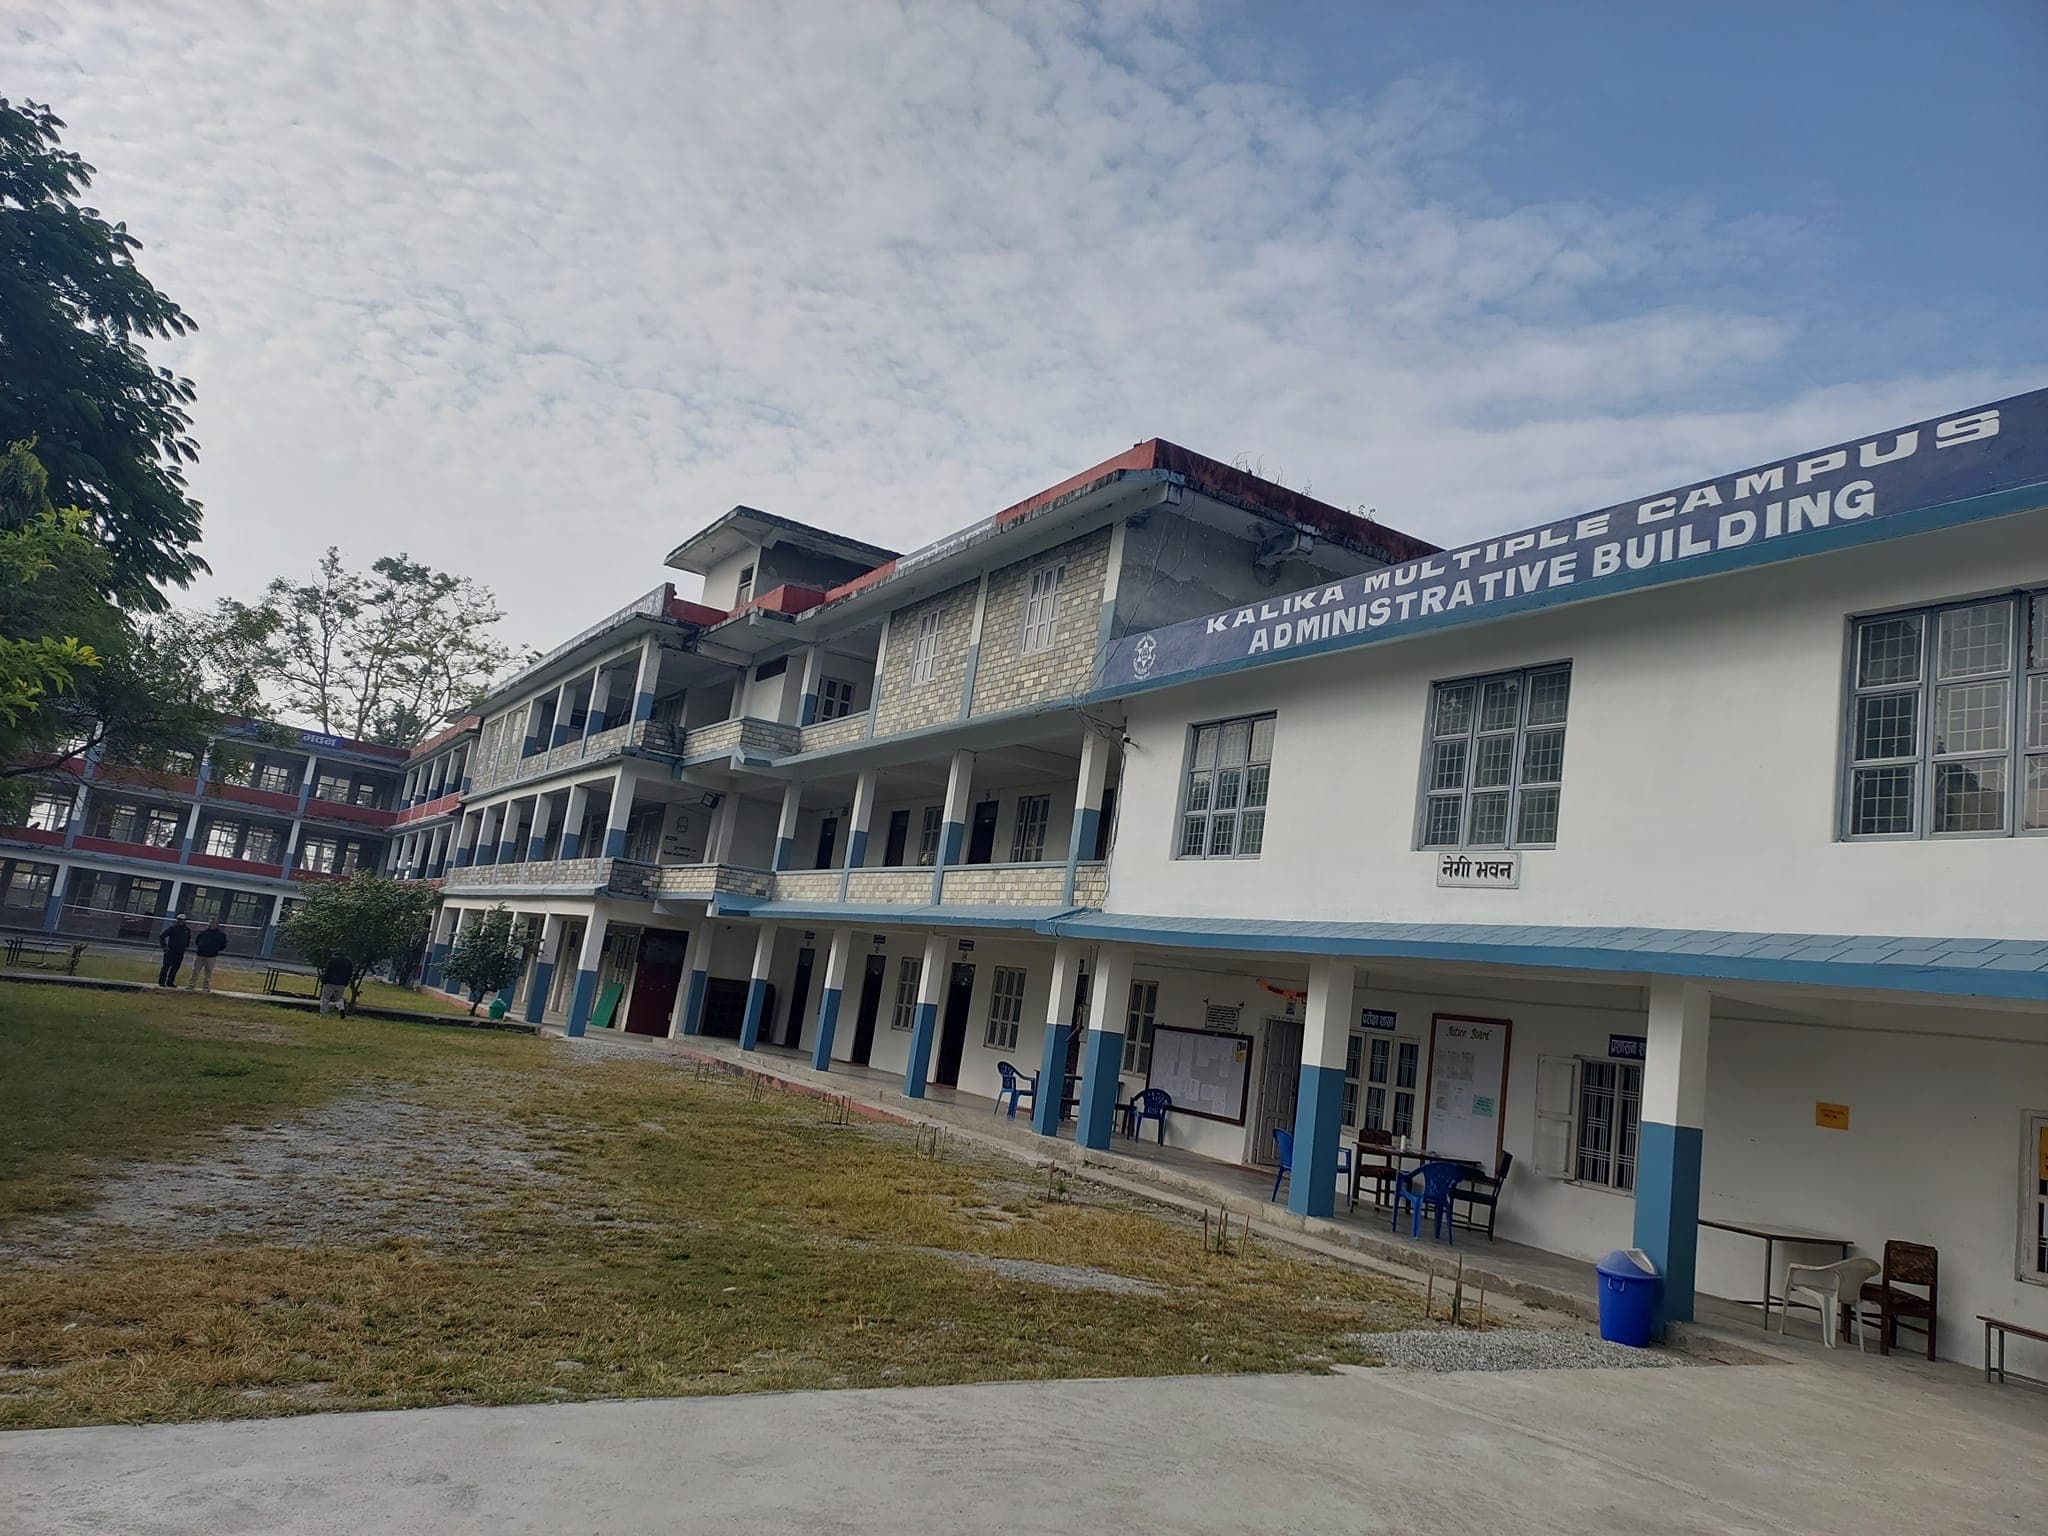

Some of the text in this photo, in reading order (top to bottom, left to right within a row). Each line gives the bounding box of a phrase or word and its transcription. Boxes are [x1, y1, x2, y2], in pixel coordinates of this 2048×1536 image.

[1206, 410, 2000, 634] KALIKA MULTIPLE CAMPUS
[1248, 480, 1875, 654] ADMINISTRATIVE BUILDING
[1442, 855, 1514, 879] नेगी भवन
